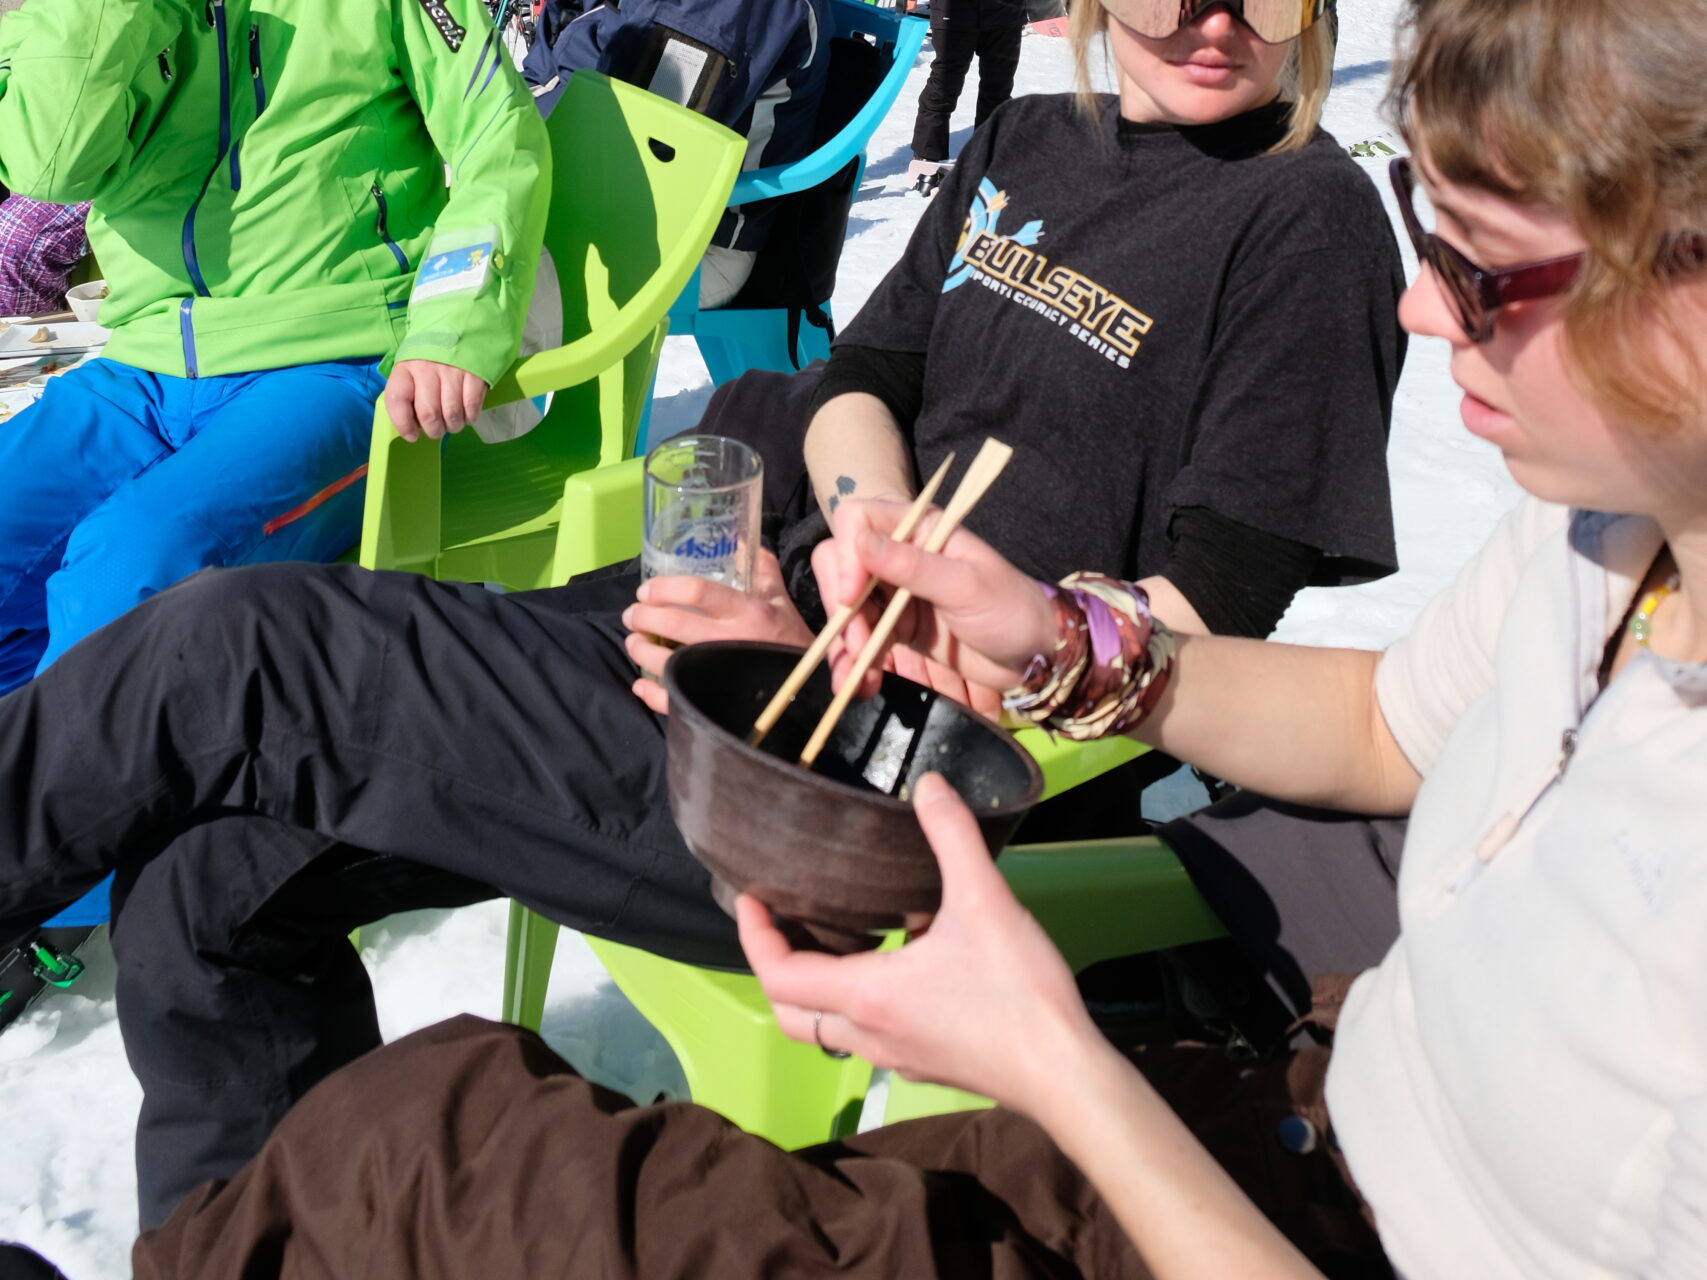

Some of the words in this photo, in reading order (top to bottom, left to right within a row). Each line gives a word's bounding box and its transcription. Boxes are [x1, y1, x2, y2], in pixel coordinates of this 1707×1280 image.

[963, 230, 1153, 357] BULLSEYE
[969, 270, 1007, 296] PORT
[1069, 322, 1131, 369] SERIES
[675, 532, 738, 559] Asahi
